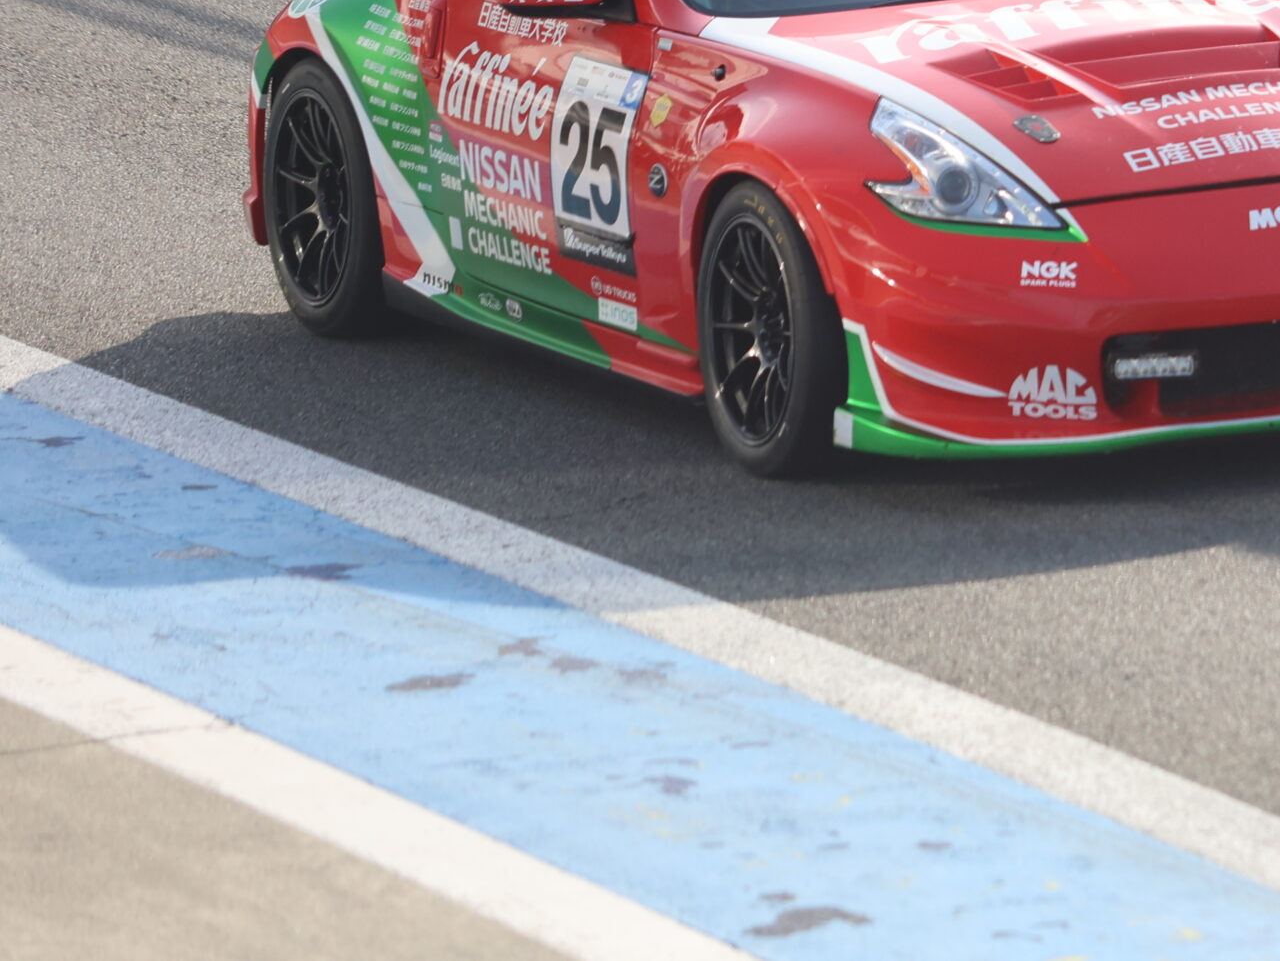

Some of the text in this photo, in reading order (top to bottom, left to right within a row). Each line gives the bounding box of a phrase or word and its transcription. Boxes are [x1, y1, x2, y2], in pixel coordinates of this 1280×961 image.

[437, 40, 554, 141] raffinée
[1092, 89, 1203, 120] NISSAN
[458, 139, 543, 203] NISSAN
[560, 100, 627, 226] 25
[463, 189, 548, 239] MECHANIC
[468, 226, 553, 275] CHALLENGE
[1020, 260, 1078, 279] NGK
[1020, 278, 1076, 288] SPARK PLUGS
[1008, 364, 1098, 405] MAC
[1008, 401, 1098, 421] TOOLS
